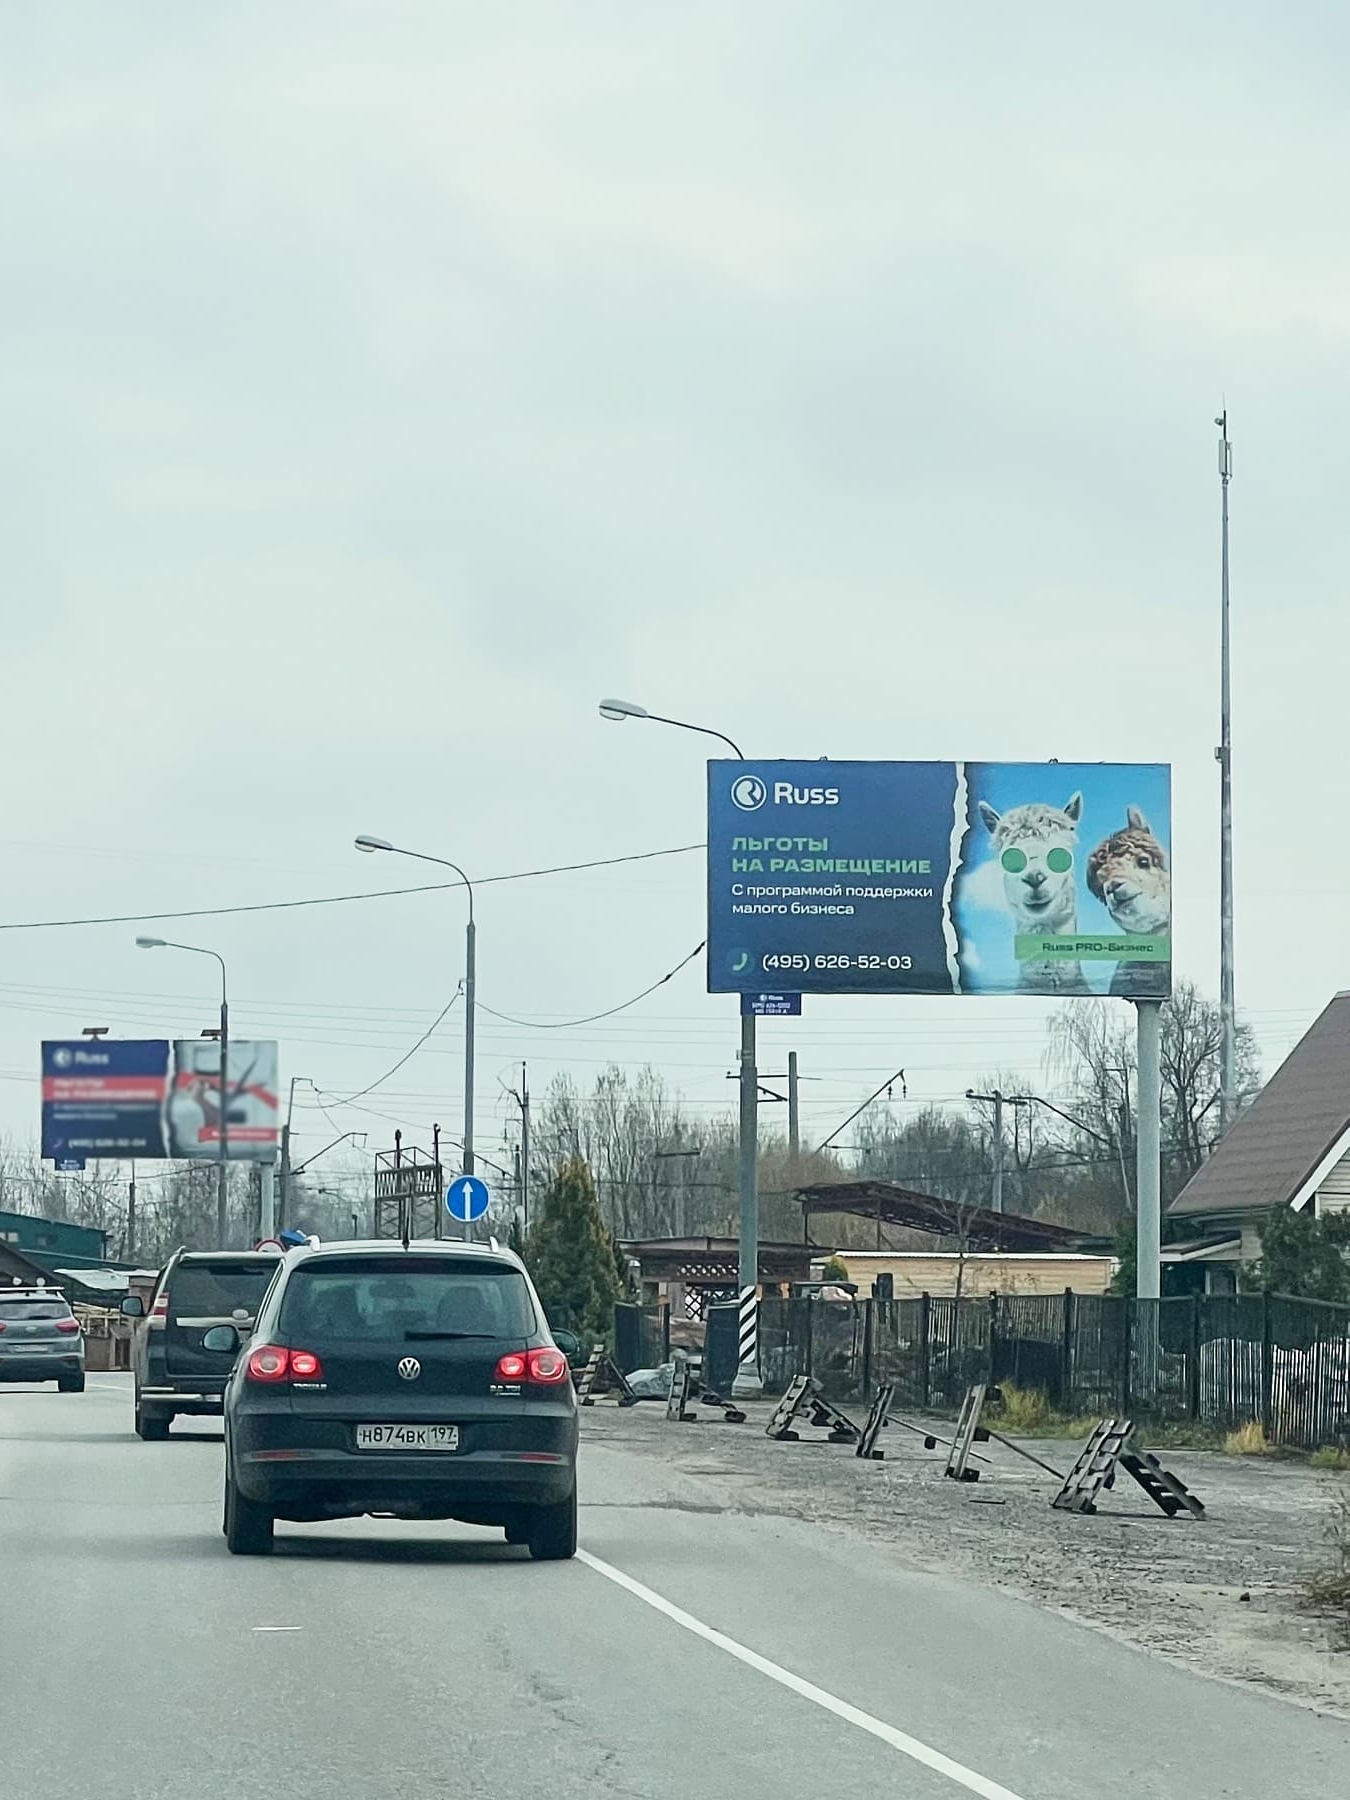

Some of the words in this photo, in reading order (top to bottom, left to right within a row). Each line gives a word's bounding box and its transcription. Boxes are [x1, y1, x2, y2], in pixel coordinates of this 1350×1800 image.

[774, 782, 839, 805] Russ
[732, 837, 828, 852] ЛЬГОТЫ
[732, 858, 764, 873] НА
[770, 859, 931, 876] РАЗМЕЩЕНИЕ
[731, 883, 744, 896] С
[746, 884, 842, 898] программой
[845, 886, 933, 900] поддержки
[732, 904, 788, 914] малого
[790, 901, 855, 915] бизнеса
[1042, 942, 1073, 952] Russ
[762, 954, 810, 972] (495)
[814, 955, 913, 970] 626-52-03
[430, 1427, 454, 1440] 197
